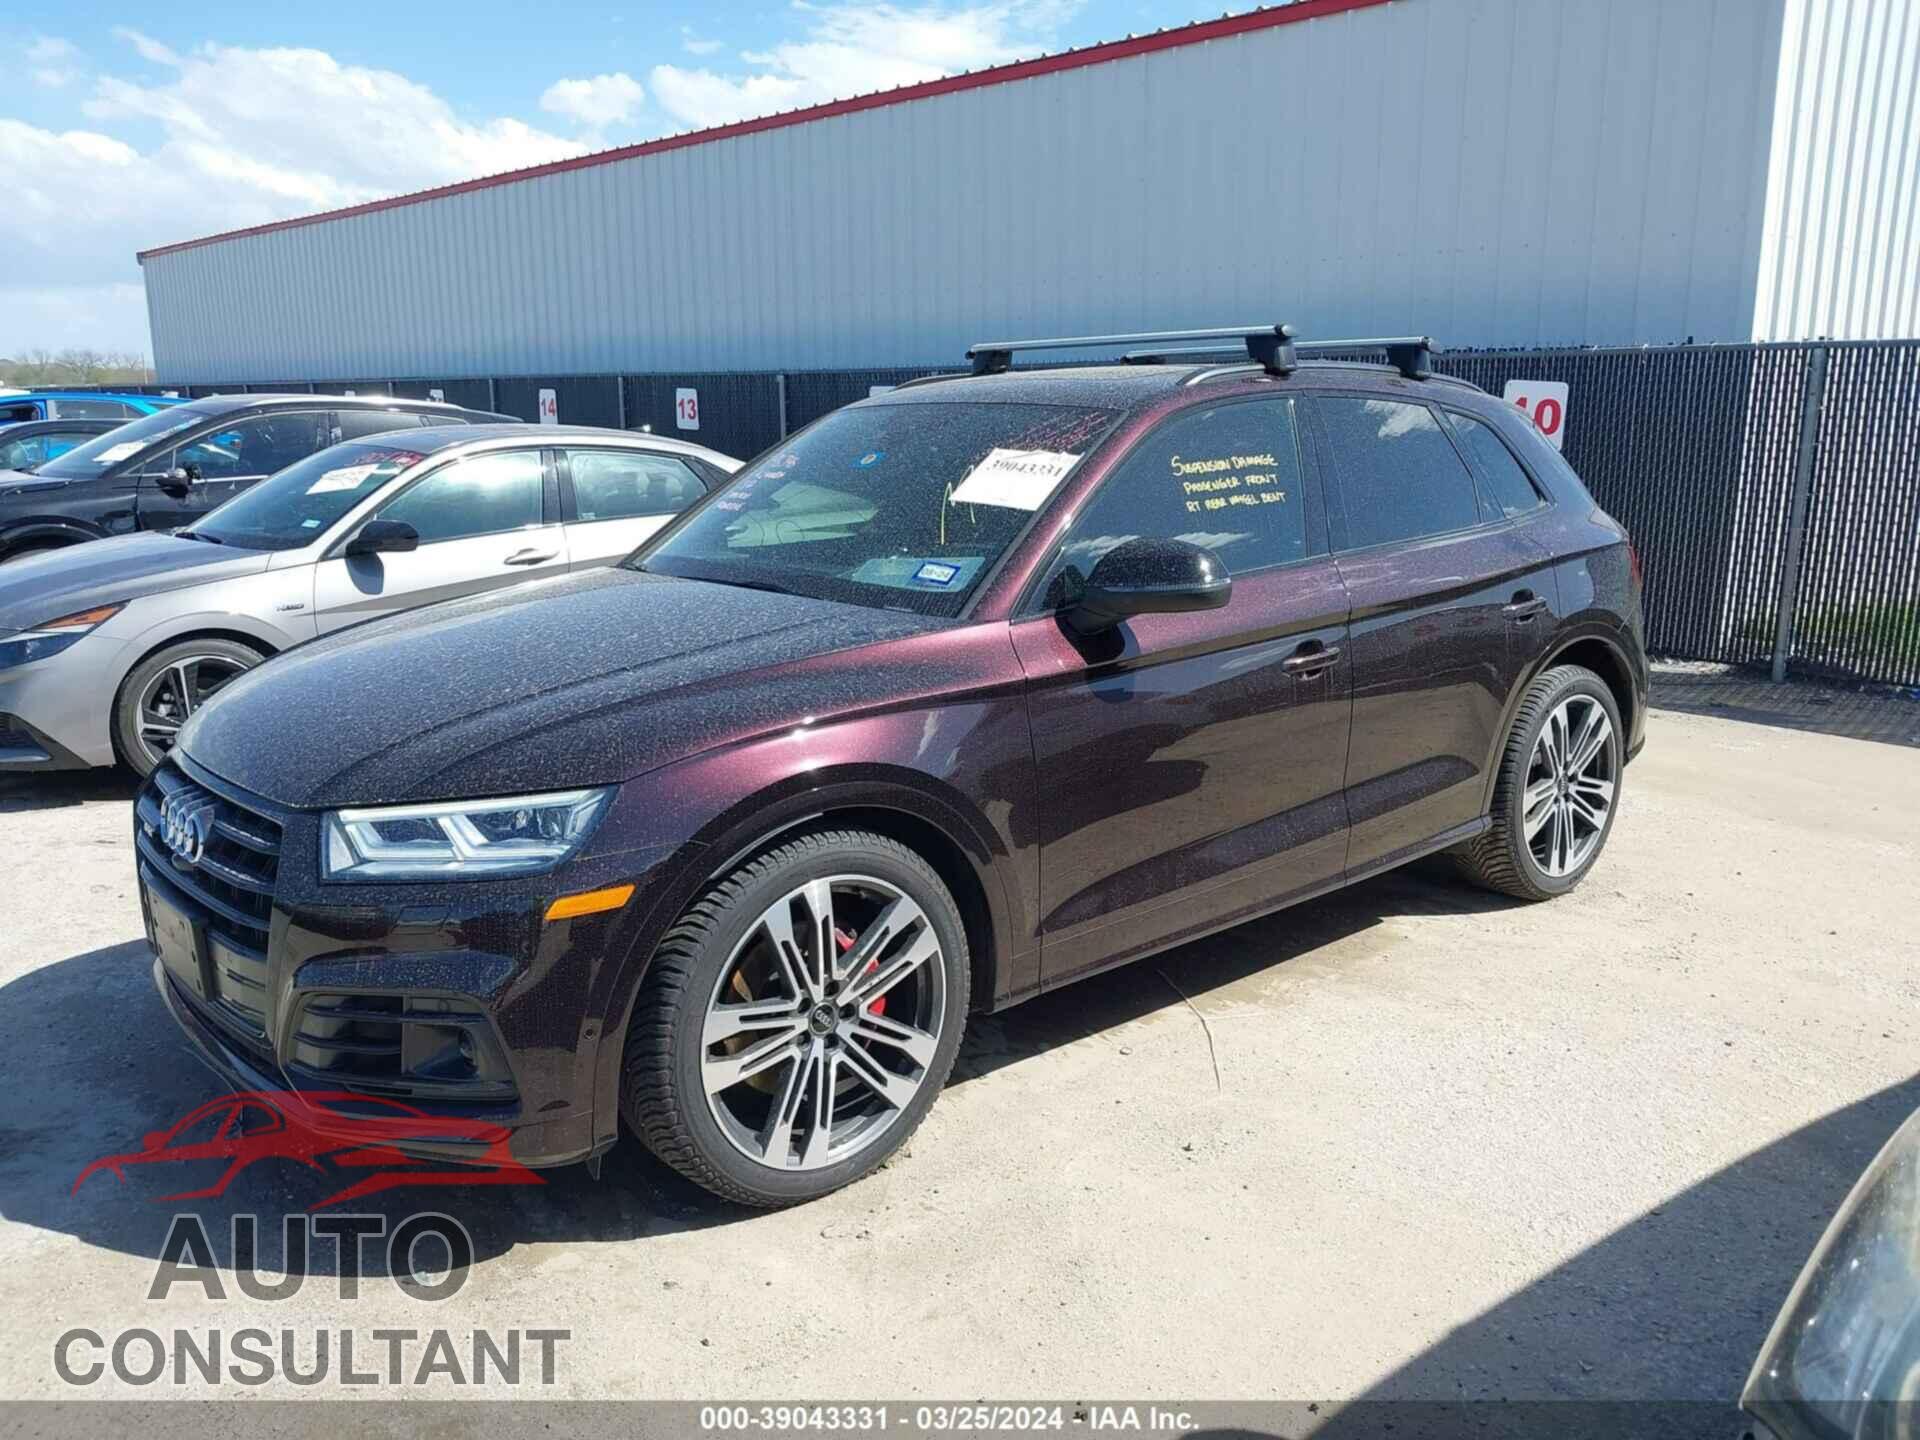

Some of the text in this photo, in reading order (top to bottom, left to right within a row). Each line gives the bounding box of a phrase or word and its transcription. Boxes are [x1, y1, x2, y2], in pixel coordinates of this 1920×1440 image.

[541, 398, 556, 416] 14
[678, 398, 697, 420] 13
[1231, 454, 1279, 469] DAMAGE
[1183, 474, 1278, 494] PASSENGER FRONT
[1186, 491, 1286, 512] RT REAR WHEEL BENT
